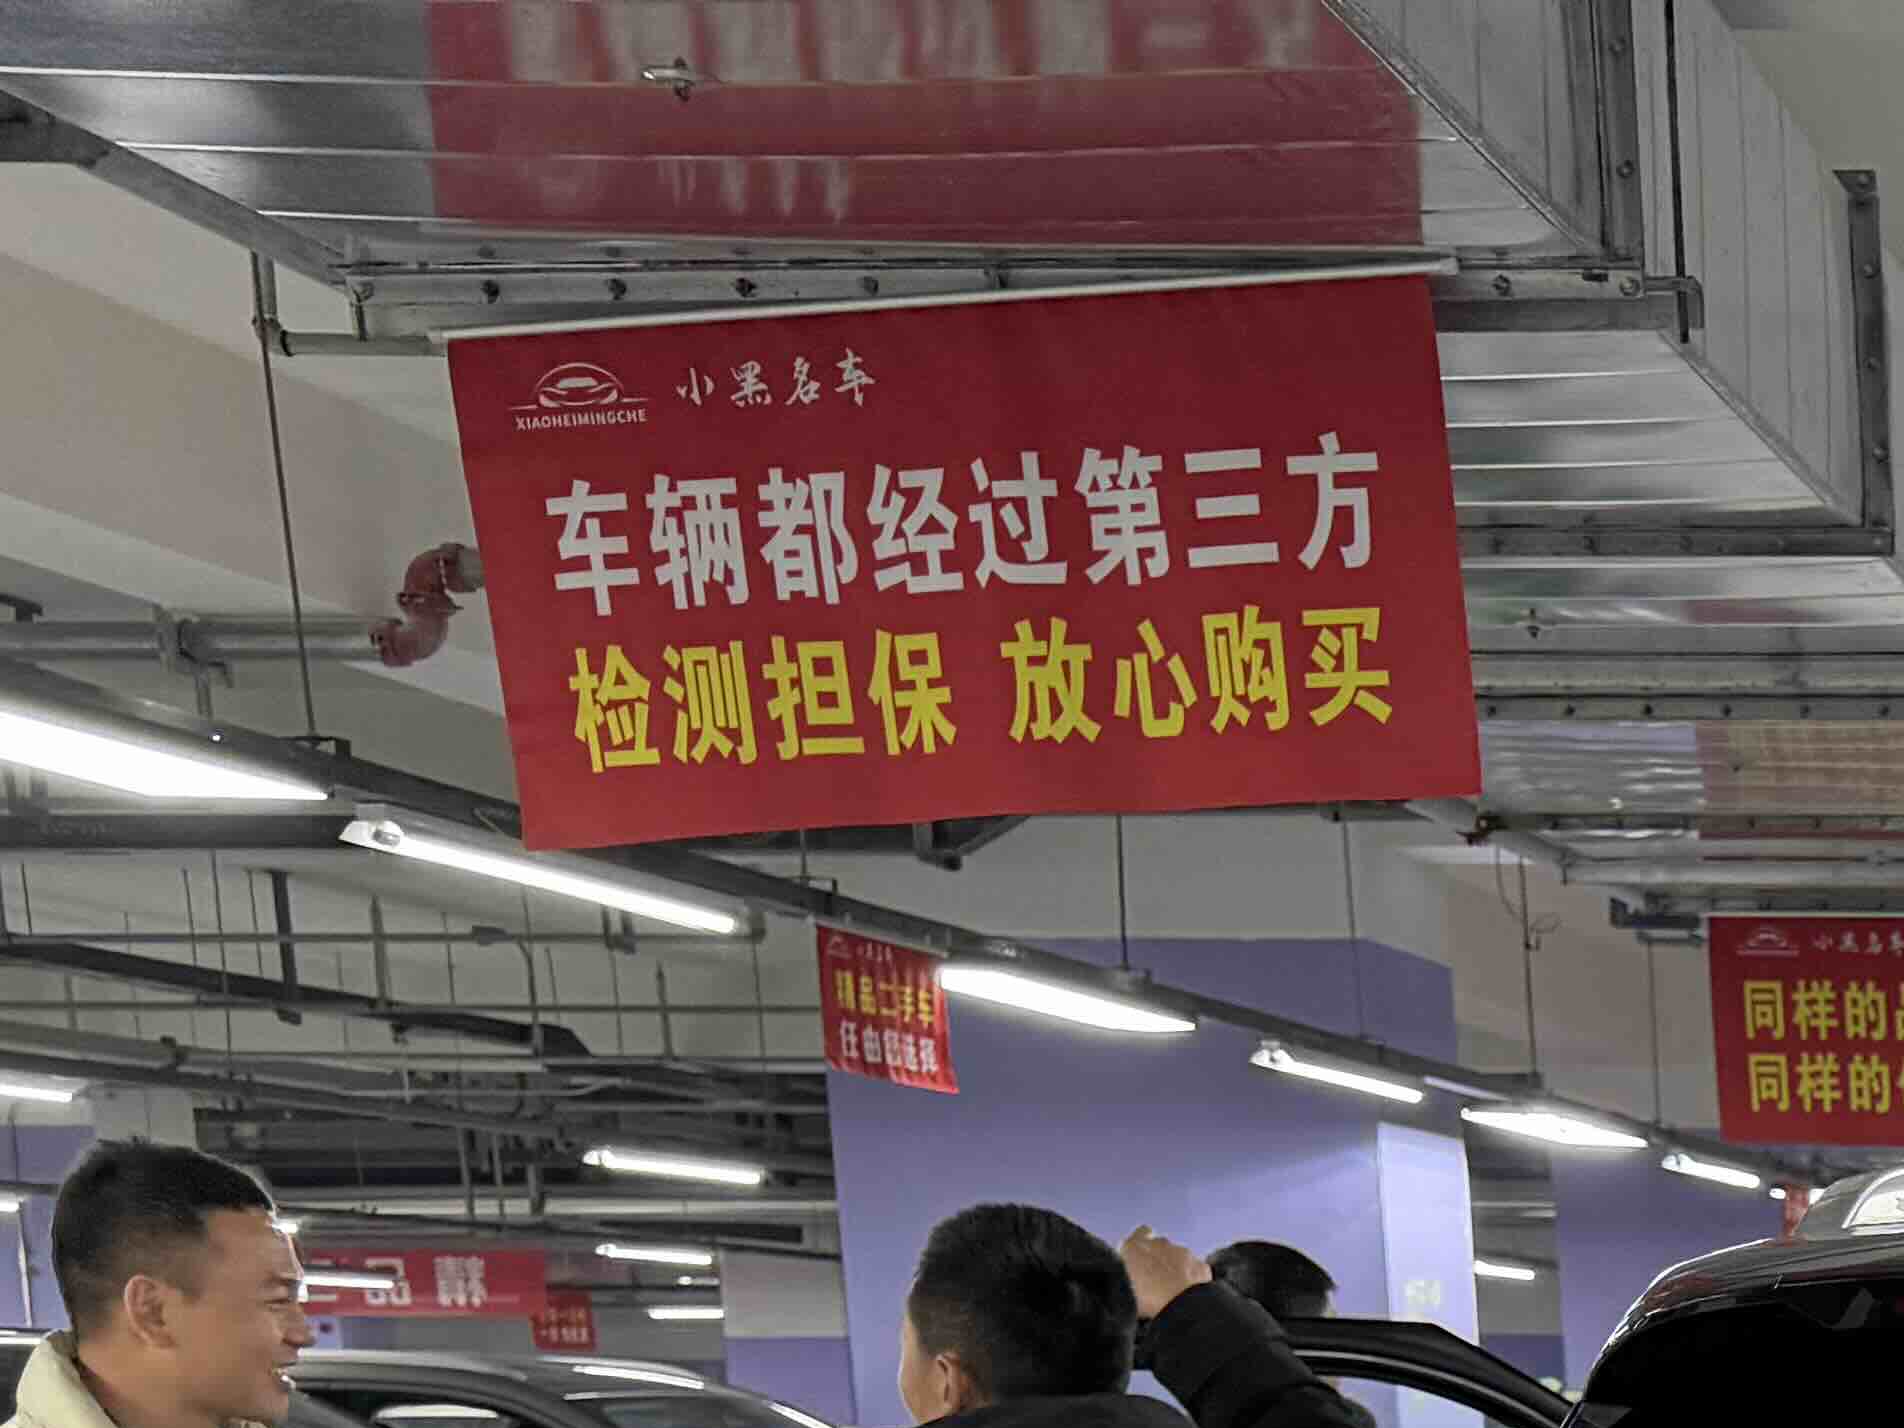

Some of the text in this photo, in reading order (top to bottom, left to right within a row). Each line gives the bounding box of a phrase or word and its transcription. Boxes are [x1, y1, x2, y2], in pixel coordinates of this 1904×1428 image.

[515, 408, 648, 432] XIAOHEIMINGCHE
[676, 347, 875, 408] 小黑名车
[545, 430, 1380, 616] 车辆都经过第三方
[568, 604, 1394, 773] 检测担保 放心购买
